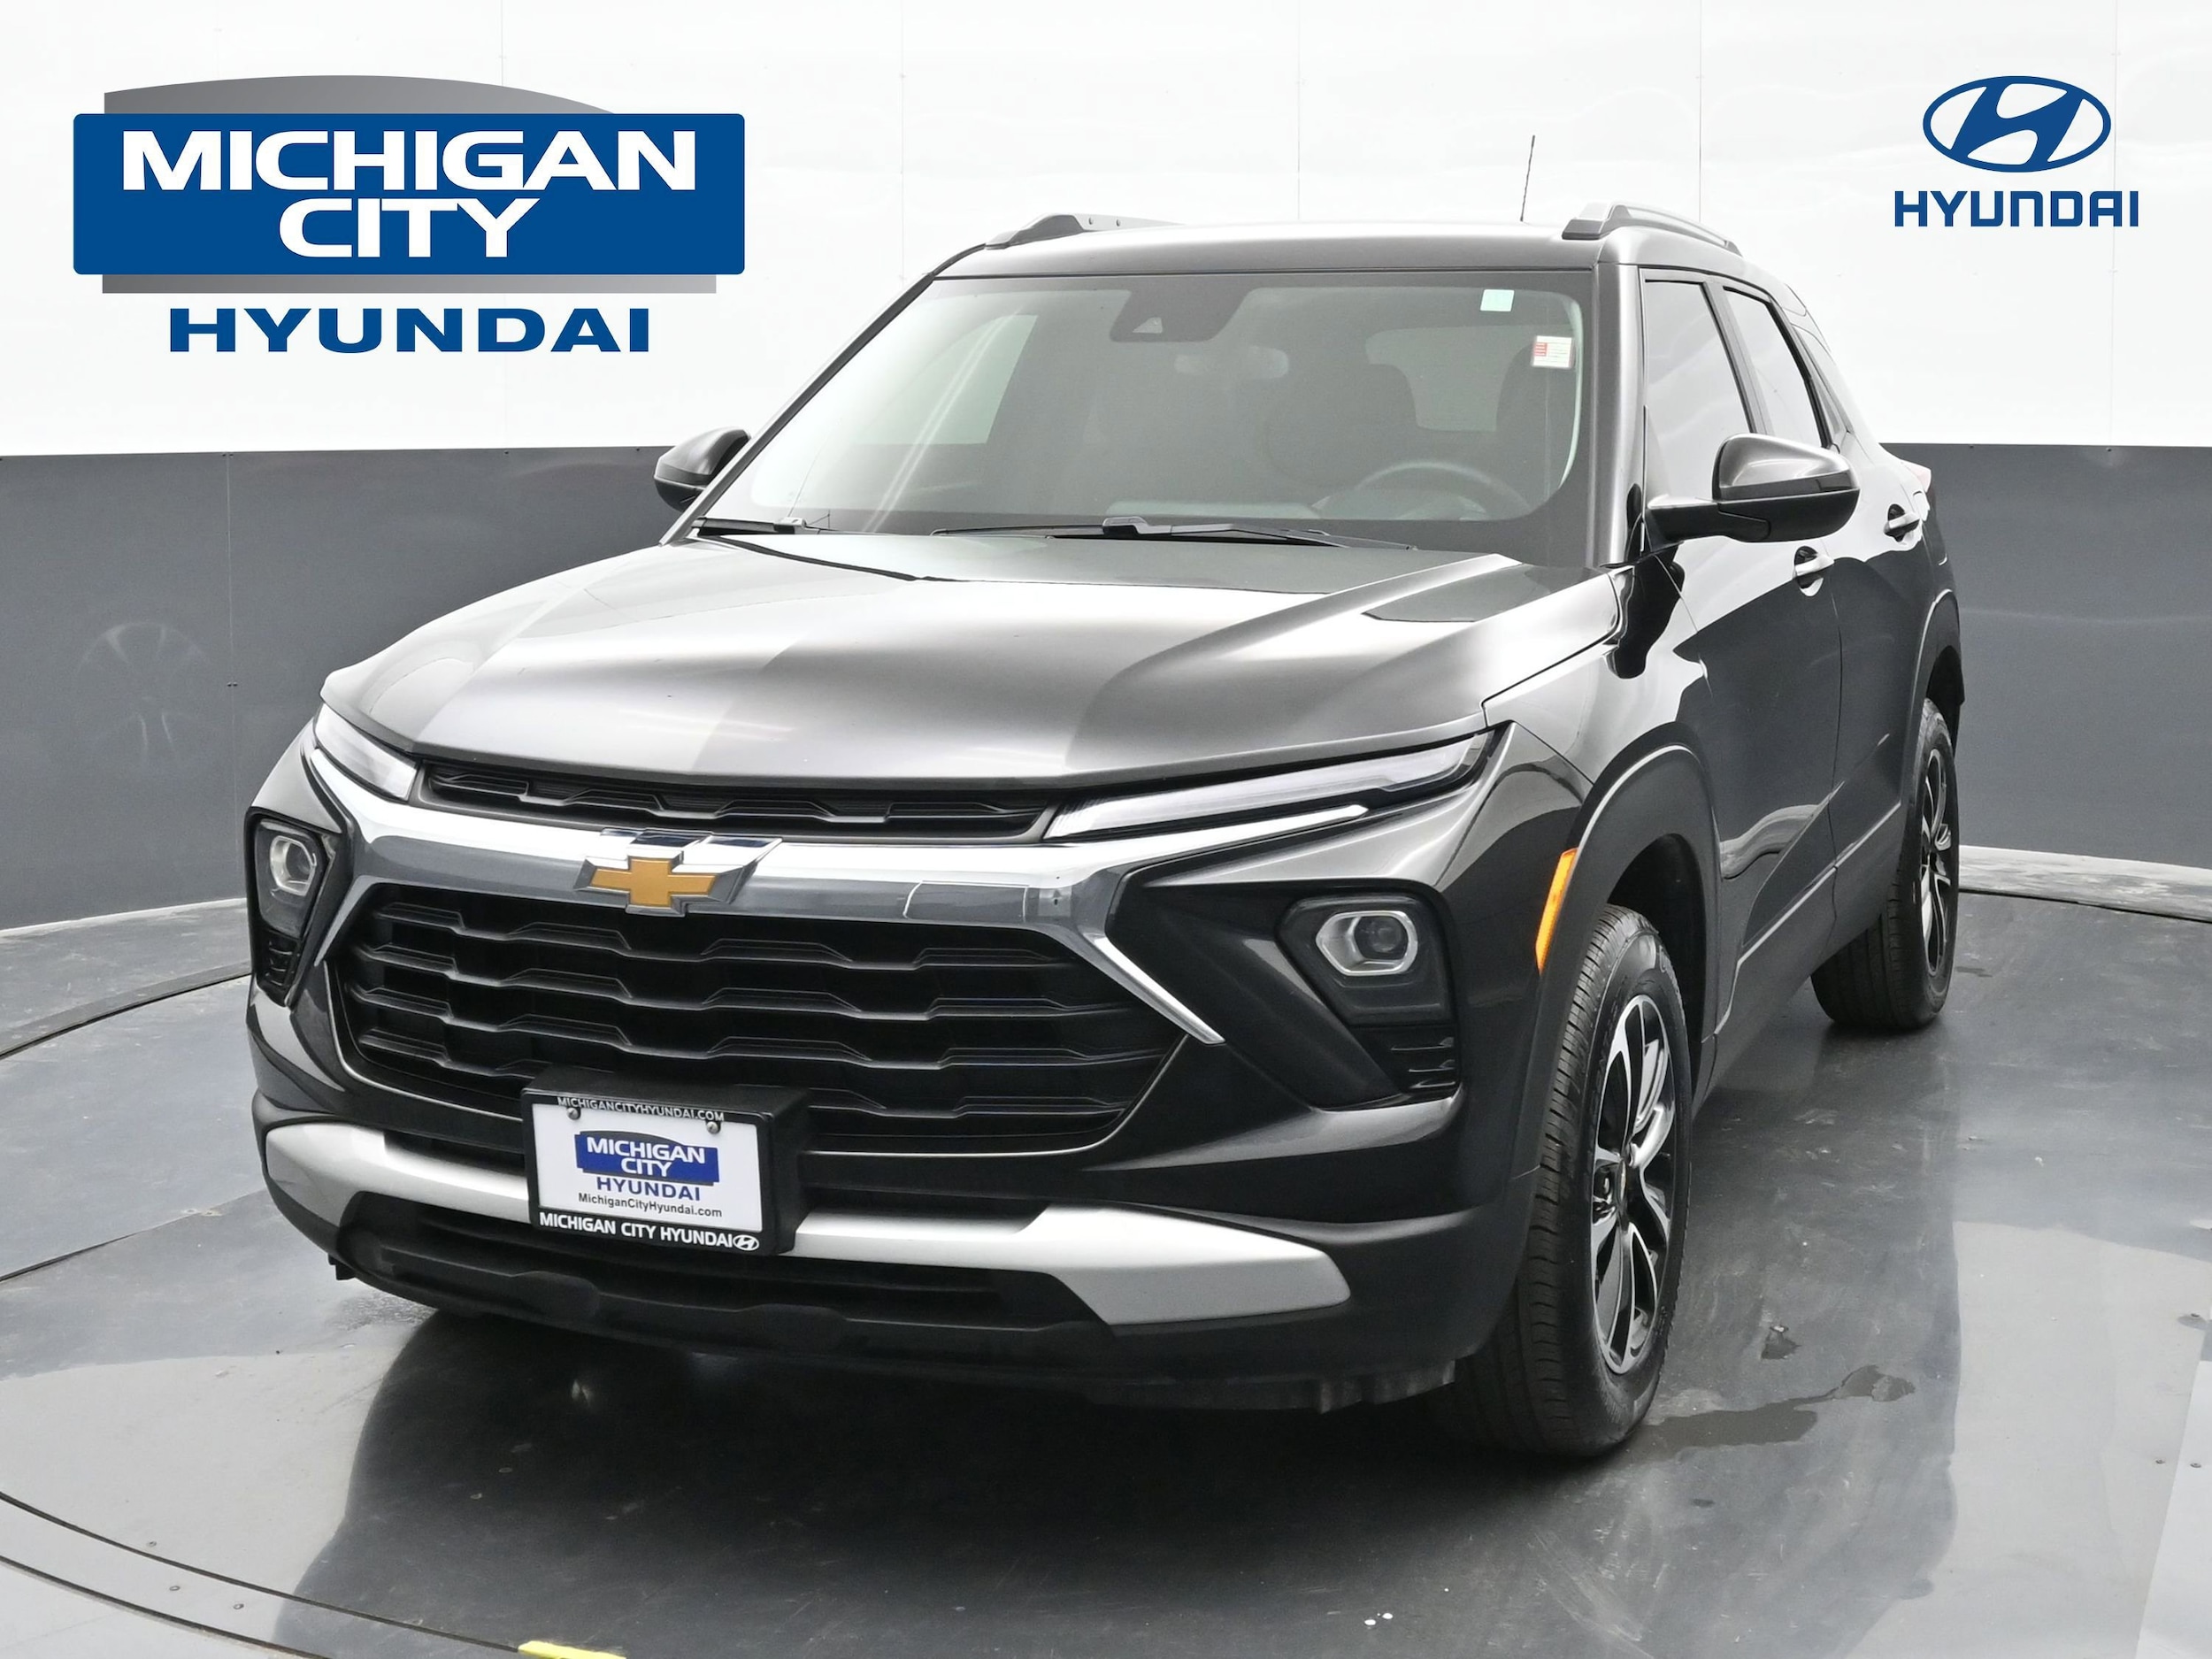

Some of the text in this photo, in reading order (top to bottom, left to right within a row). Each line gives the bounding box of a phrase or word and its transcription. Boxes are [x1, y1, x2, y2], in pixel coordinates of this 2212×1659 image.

[557, 1096, 725, 1122] MICHIGANCITYHYUNDAI.COM
[587, 1137, 705, 1164] MICHIGAN
[620, 1158, 672, 1177] CITY
[596, 1176, 701, 1202] HYUNDAI
[578, 1193, 723, 1217] MichiganCityHyundai.com
[539, 1211, 733, 1248] MICHIGAN CITY HYUNDAI
